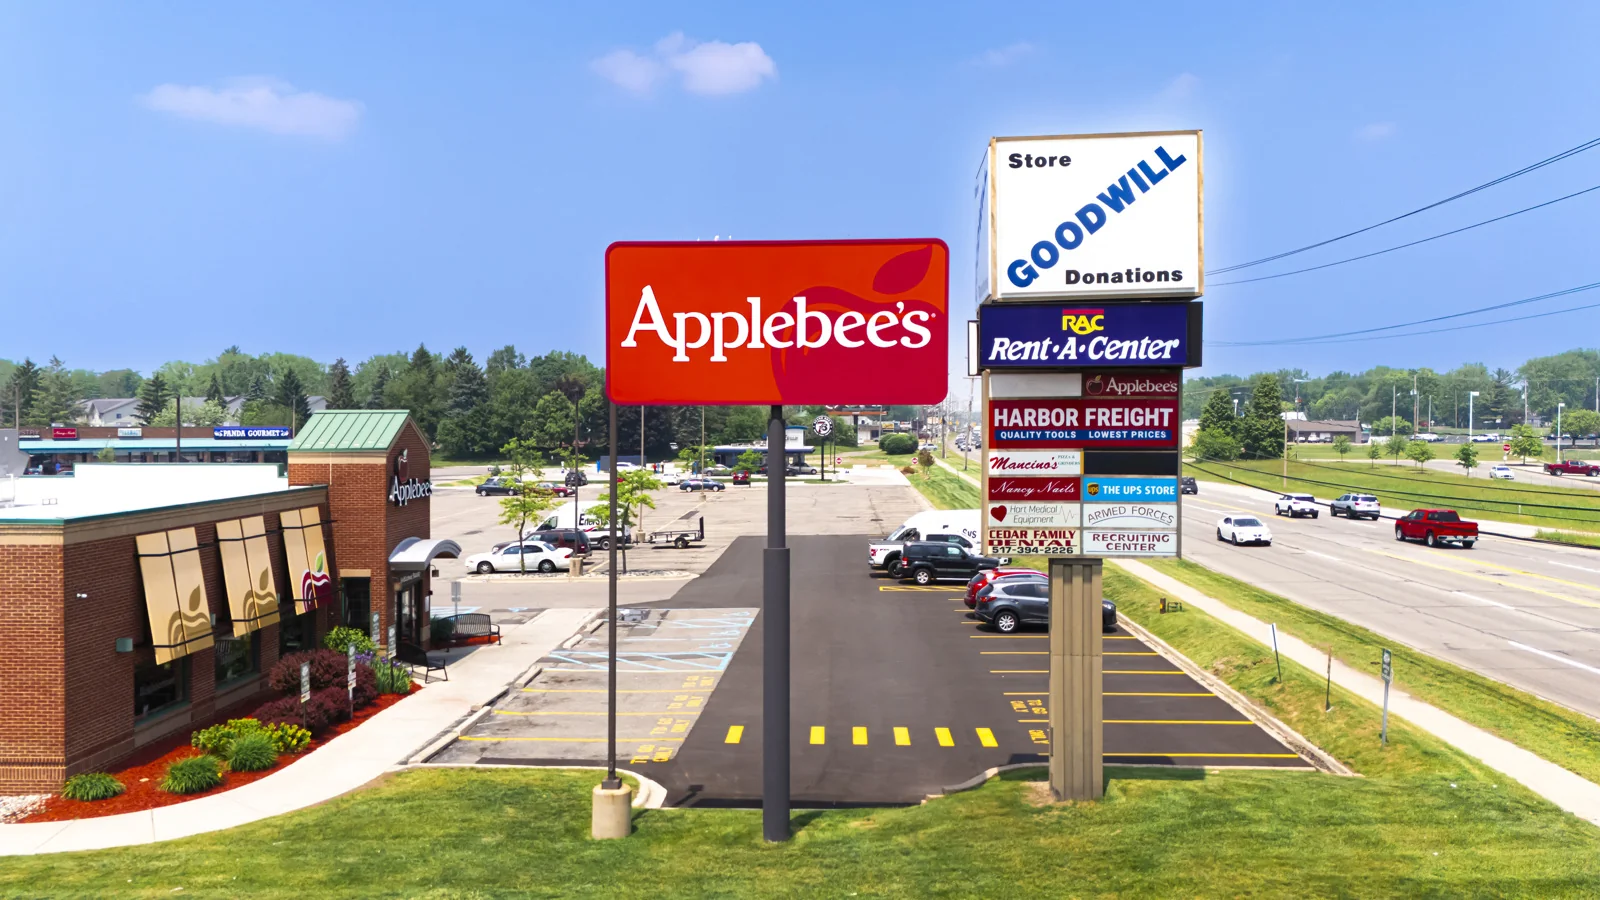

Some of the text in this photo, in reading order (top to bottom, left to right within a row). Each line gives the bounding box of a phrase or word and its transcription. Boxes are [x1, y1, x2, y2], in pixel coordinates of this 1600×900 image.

[1008, 153, 1071, 169] Store
[1007, 145, 1187, 288] GOODWILL
[1065, 268, 1183, 284] Donations
[621, 285, 931, 362] Applebee's
[1062, 315, 1105, 335] RAC
[1106, 377, 1177, 394] Applebee's
[994, 408, 1173, 427] HARBOR FREIGHT
[1001, 431, 1041, 439] QUALITY
[990, 457, 1058, 469] Mancino's
[992, 481, 1075, 496] Nancy Nails
[1088, 486, 1099, 495] ups
[1103, 485, 1175, 495] THE UPS STORE
[1029, 505, 1058, 513] Medical
[1088, 506, 1174, 524] ARMED FORCES
[1014, 515, 1054, 524] Equipment
[989, 530, 1076, 539] CEDAR FAMILY
[1092, 534, 1169, 542] RECRUITING
[1106, 542, 1155, 551] CENTER
